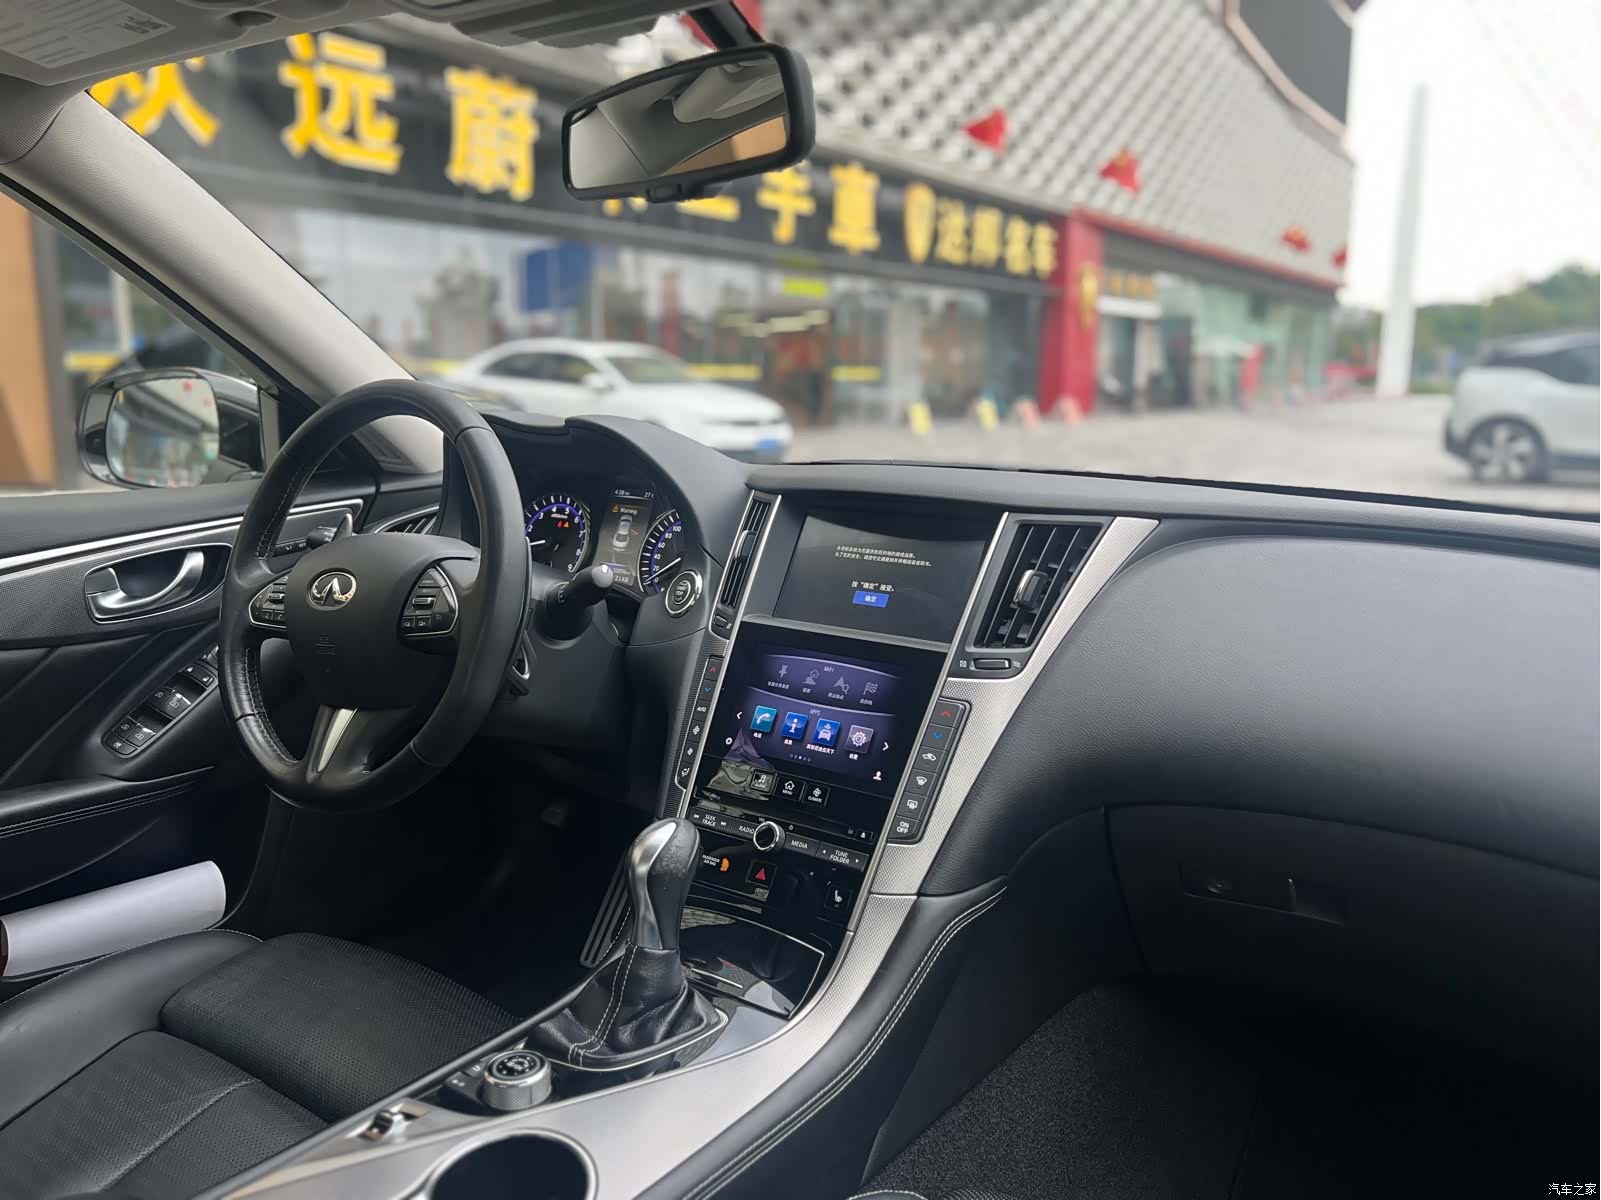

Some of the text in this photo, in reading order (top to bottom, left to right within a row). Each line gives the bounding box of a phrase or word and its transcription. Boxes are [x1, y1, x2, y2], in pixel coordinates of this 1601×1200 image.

[564, 506, 570, 514] 5
[620, 507, 638, 515] Warning
[538, 512, 544, 520] 3
[578, 530, 584, 538] 7
[575, 548, 581, 556] 8
[567, 563, 573, 571] 9
[864, 594, 878, 603] 确定
[809, 708, 821, 716] APPS
[701, 819, 717, 827] TRACK
[899, 821, 910, 829] ON
[738, 825, 755, 834] RADIO
[896, 826, 909, 834] OFF
[791, 840, 808, 849] MEDIA
[834, 849, 849, 858] TUNE
[829, 854, 850, 865] FOLDER
